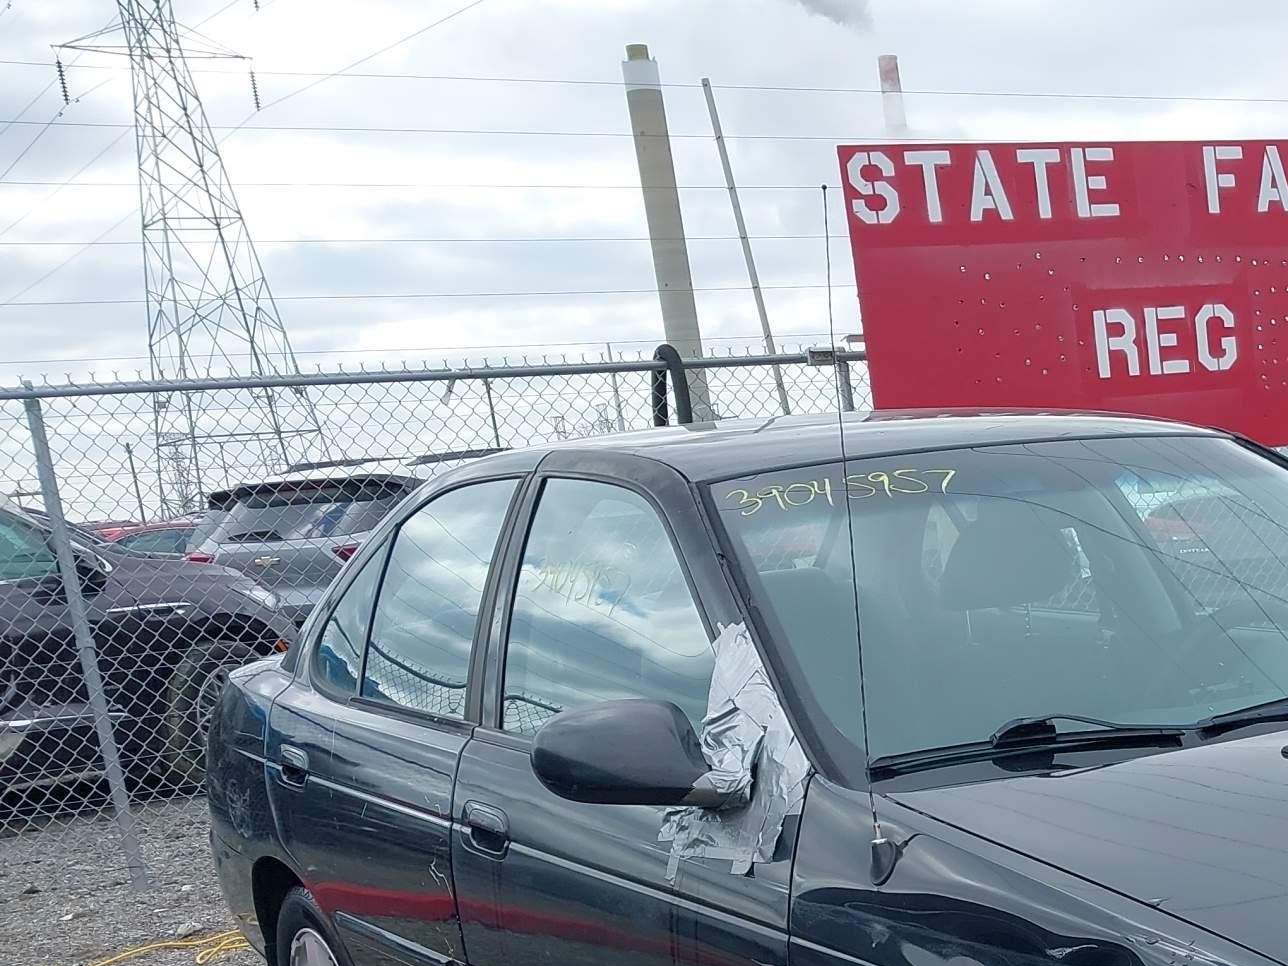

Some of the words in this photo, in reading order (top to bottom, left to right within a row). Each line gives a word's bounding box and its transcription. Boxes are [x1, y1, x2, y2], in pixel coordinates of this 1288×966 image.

[846, 147, 1120, 225] STATE
[1092, 303, 1239, 379] REG
[726, 469, 956, 516] 39045957
